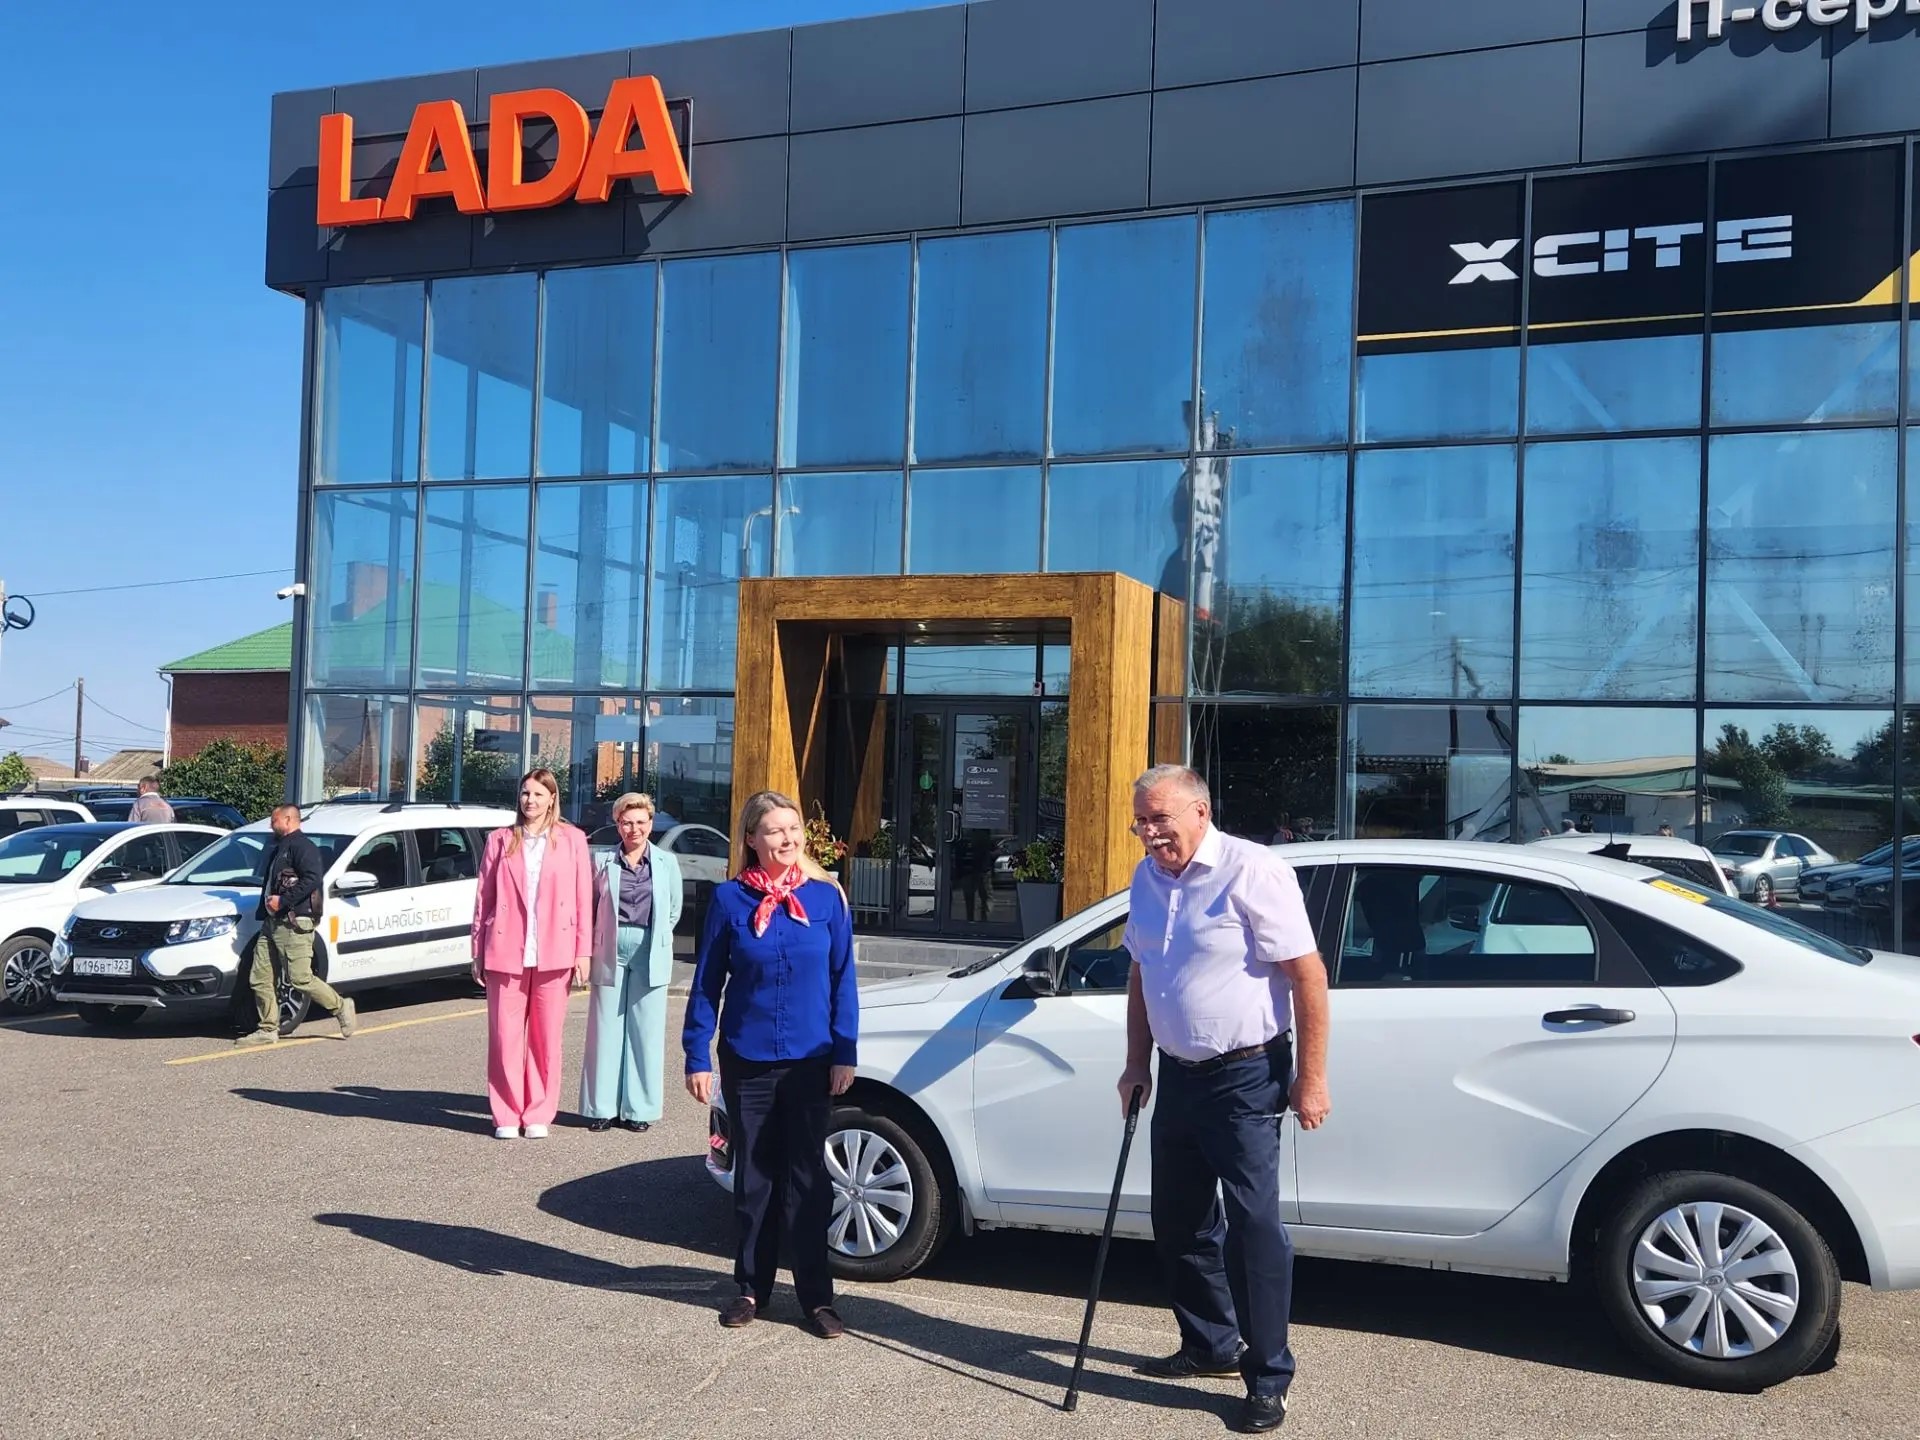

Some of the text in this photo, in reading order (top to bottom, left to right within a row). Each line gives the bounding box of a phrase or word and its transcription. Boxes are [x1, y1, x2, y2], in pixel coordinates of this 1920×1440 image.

[317, 75, 692, 227] LADA
[1447, 214, 1793, 285] XCITE
[344, 907, 452, 935] LADA LARGUS ТЕСТ
